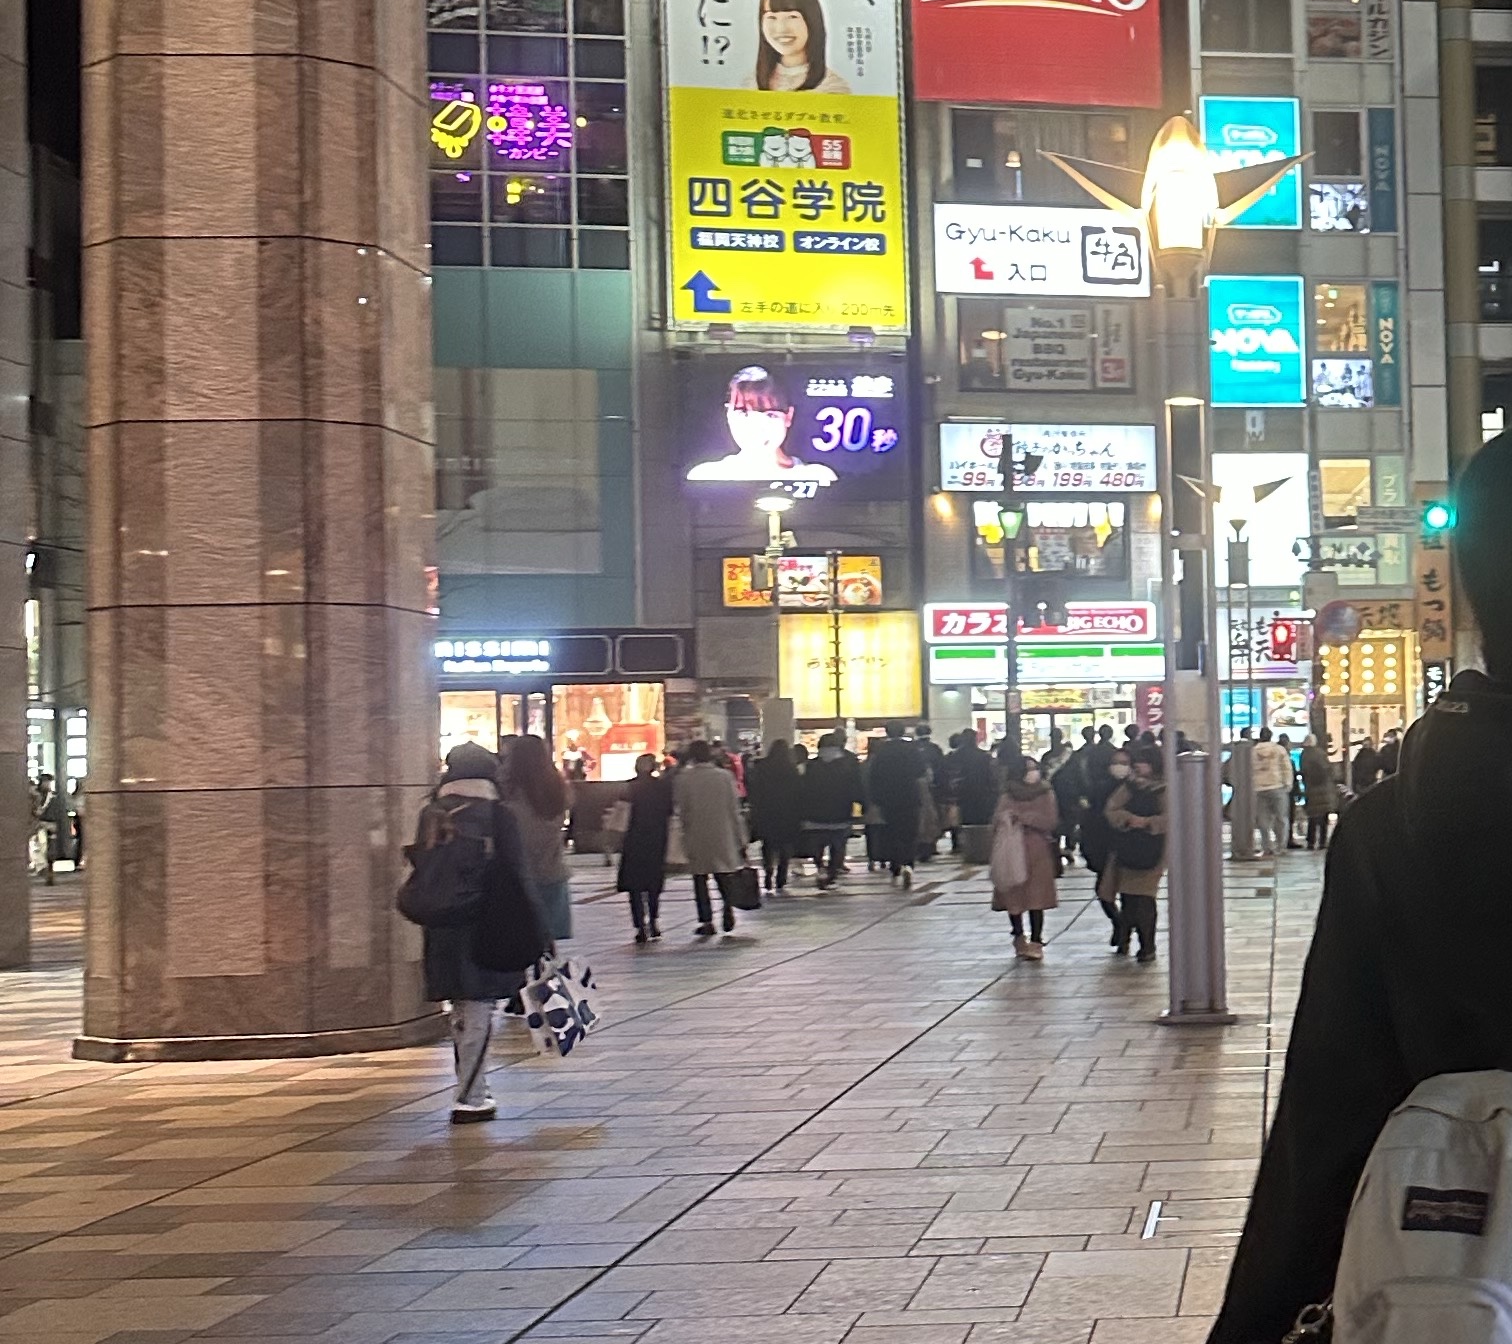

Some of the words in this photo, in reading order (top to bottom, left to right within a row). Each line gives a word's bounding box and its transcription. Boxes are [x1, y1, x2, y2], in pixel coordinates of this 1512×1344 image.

[687, 175, 887, 223] 四谷学院
[696, 231, 780, 249] 福岡天神校
[798, 235, 881, 252] オンライン校
[945, 222, 1071, 245] Gyu-Kaku
[1089, 237, 1136, 271] 牛角
[1008, 262, 1047, 282] 入口
[740, 301, 831, 315] 左手の道に入
[1377, 317, 1395, 365] NOVA
